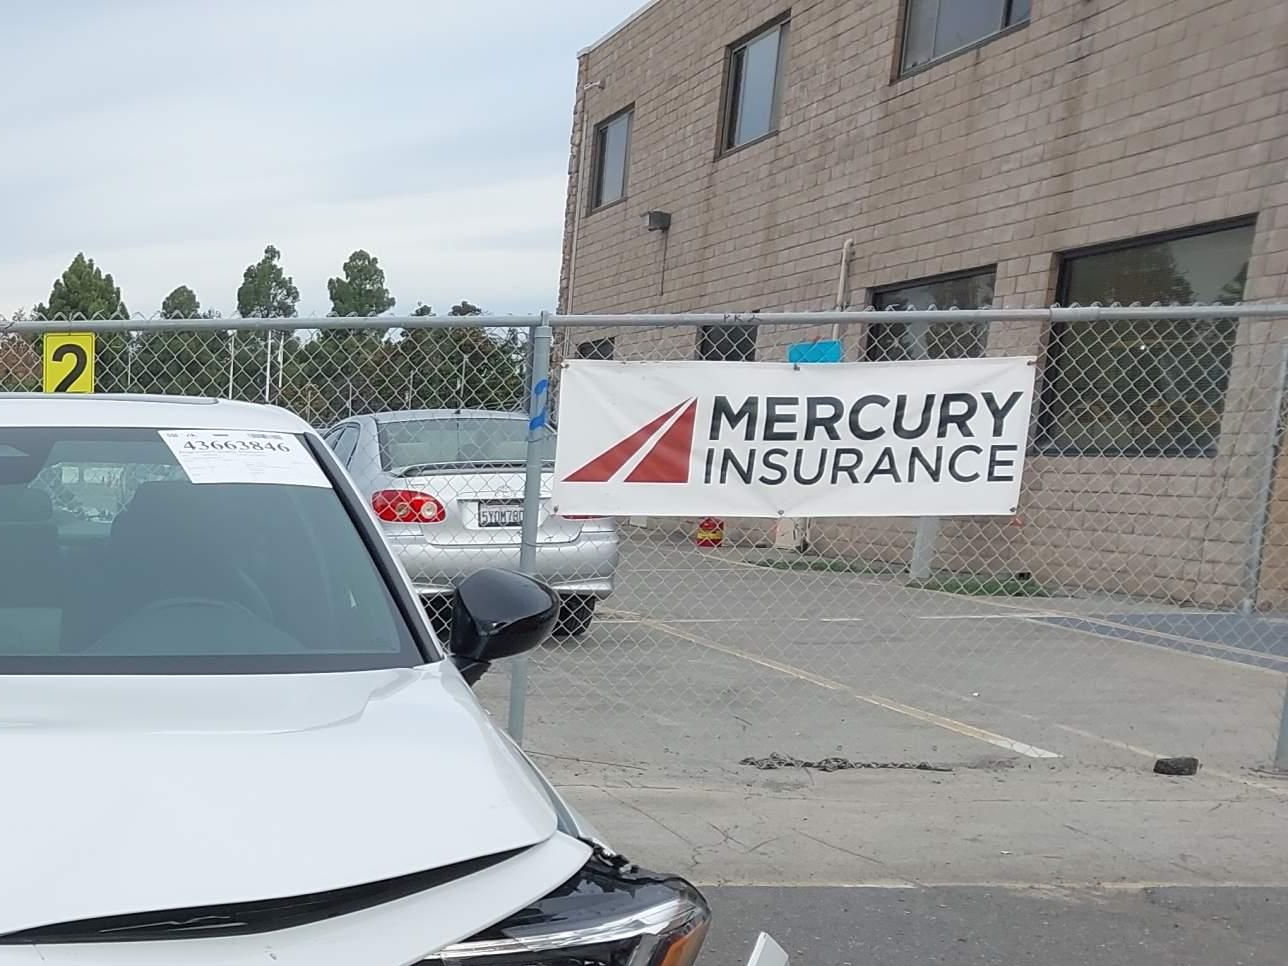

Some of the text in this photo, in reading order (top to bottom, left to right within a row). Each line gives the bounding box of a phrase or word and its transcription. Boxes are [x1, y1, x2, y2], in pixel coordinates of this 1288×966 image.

[52, 344, 88, 392] 2
[710, 391, 1024, 441] MERCURY
[183, 440, 291, 453] 43663846
[704, 444, 1018, 486] INSURANCE
